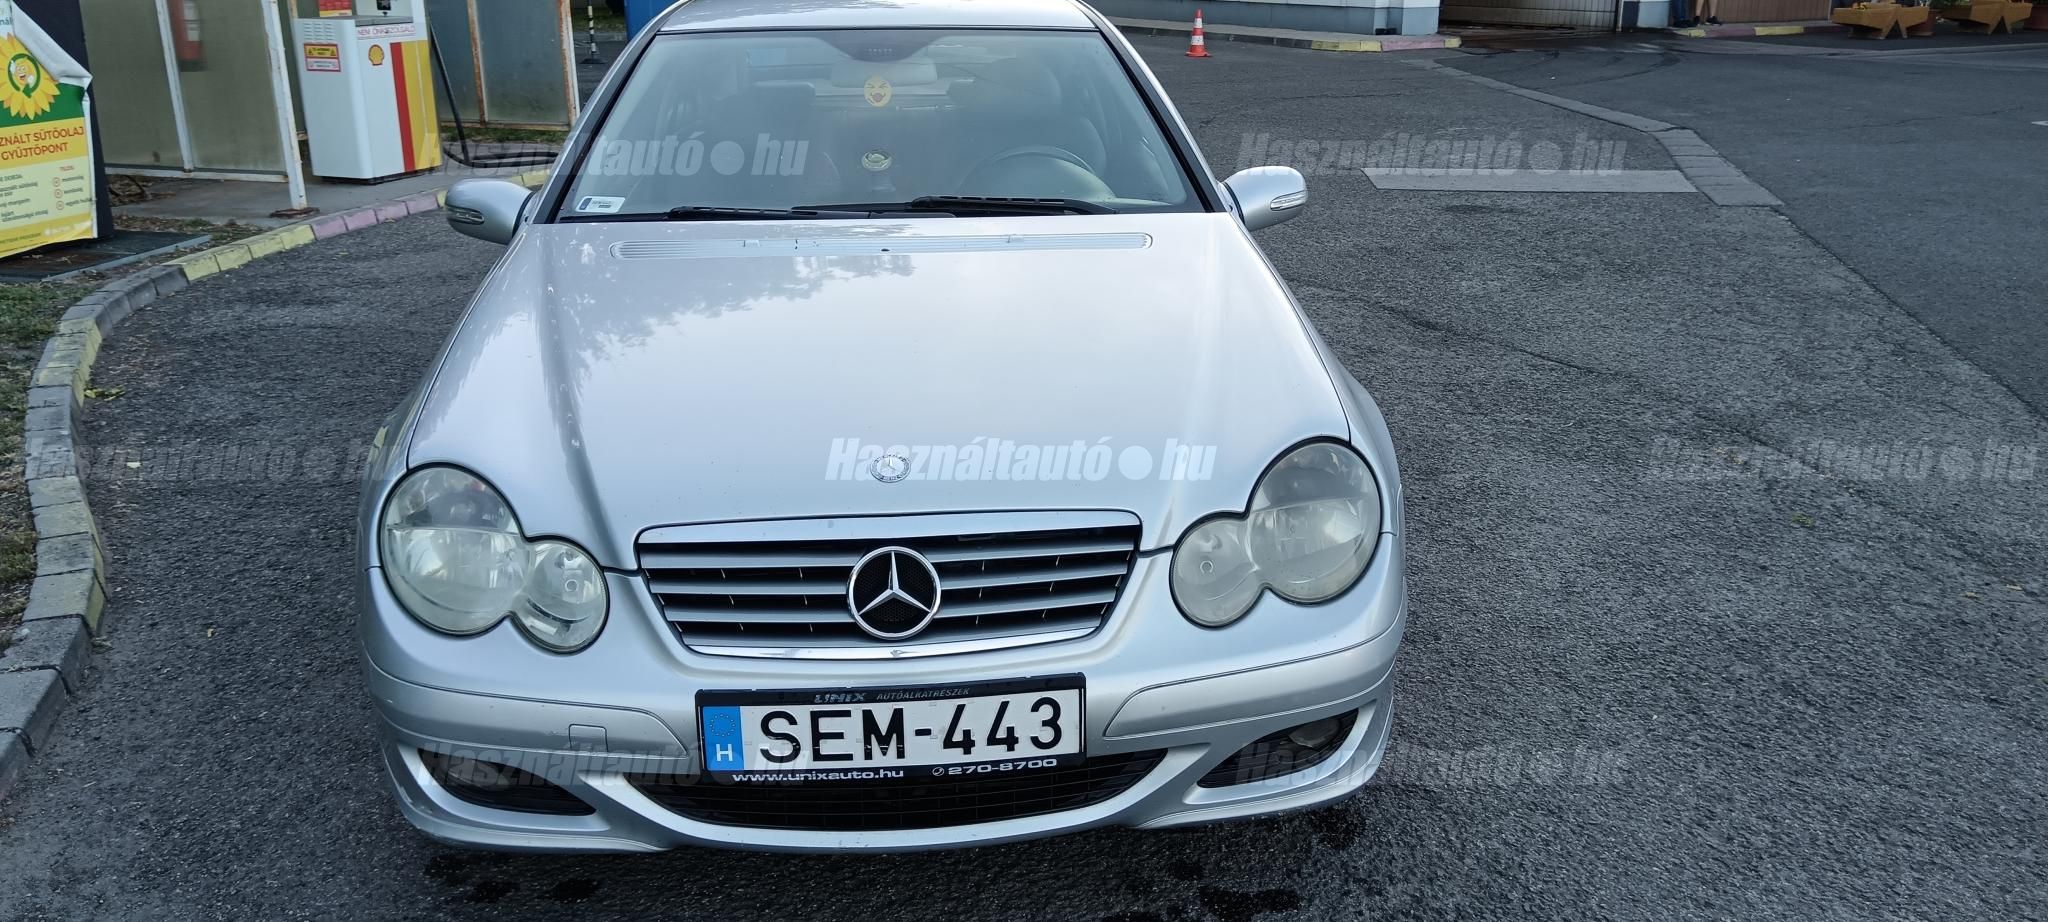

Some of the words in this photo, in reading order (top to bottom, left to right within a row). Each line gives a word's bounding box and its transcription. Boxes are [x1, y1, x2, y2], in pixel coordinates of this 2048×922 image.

[814, 692, 866, 704] UNIX
[715, 743, 733, 762] H
[759, 696, 1063, 764] SEM-443
[731, 768, 904, 782] www.unixauto.hu
[947, 758, 1057, 775] 270-8700
